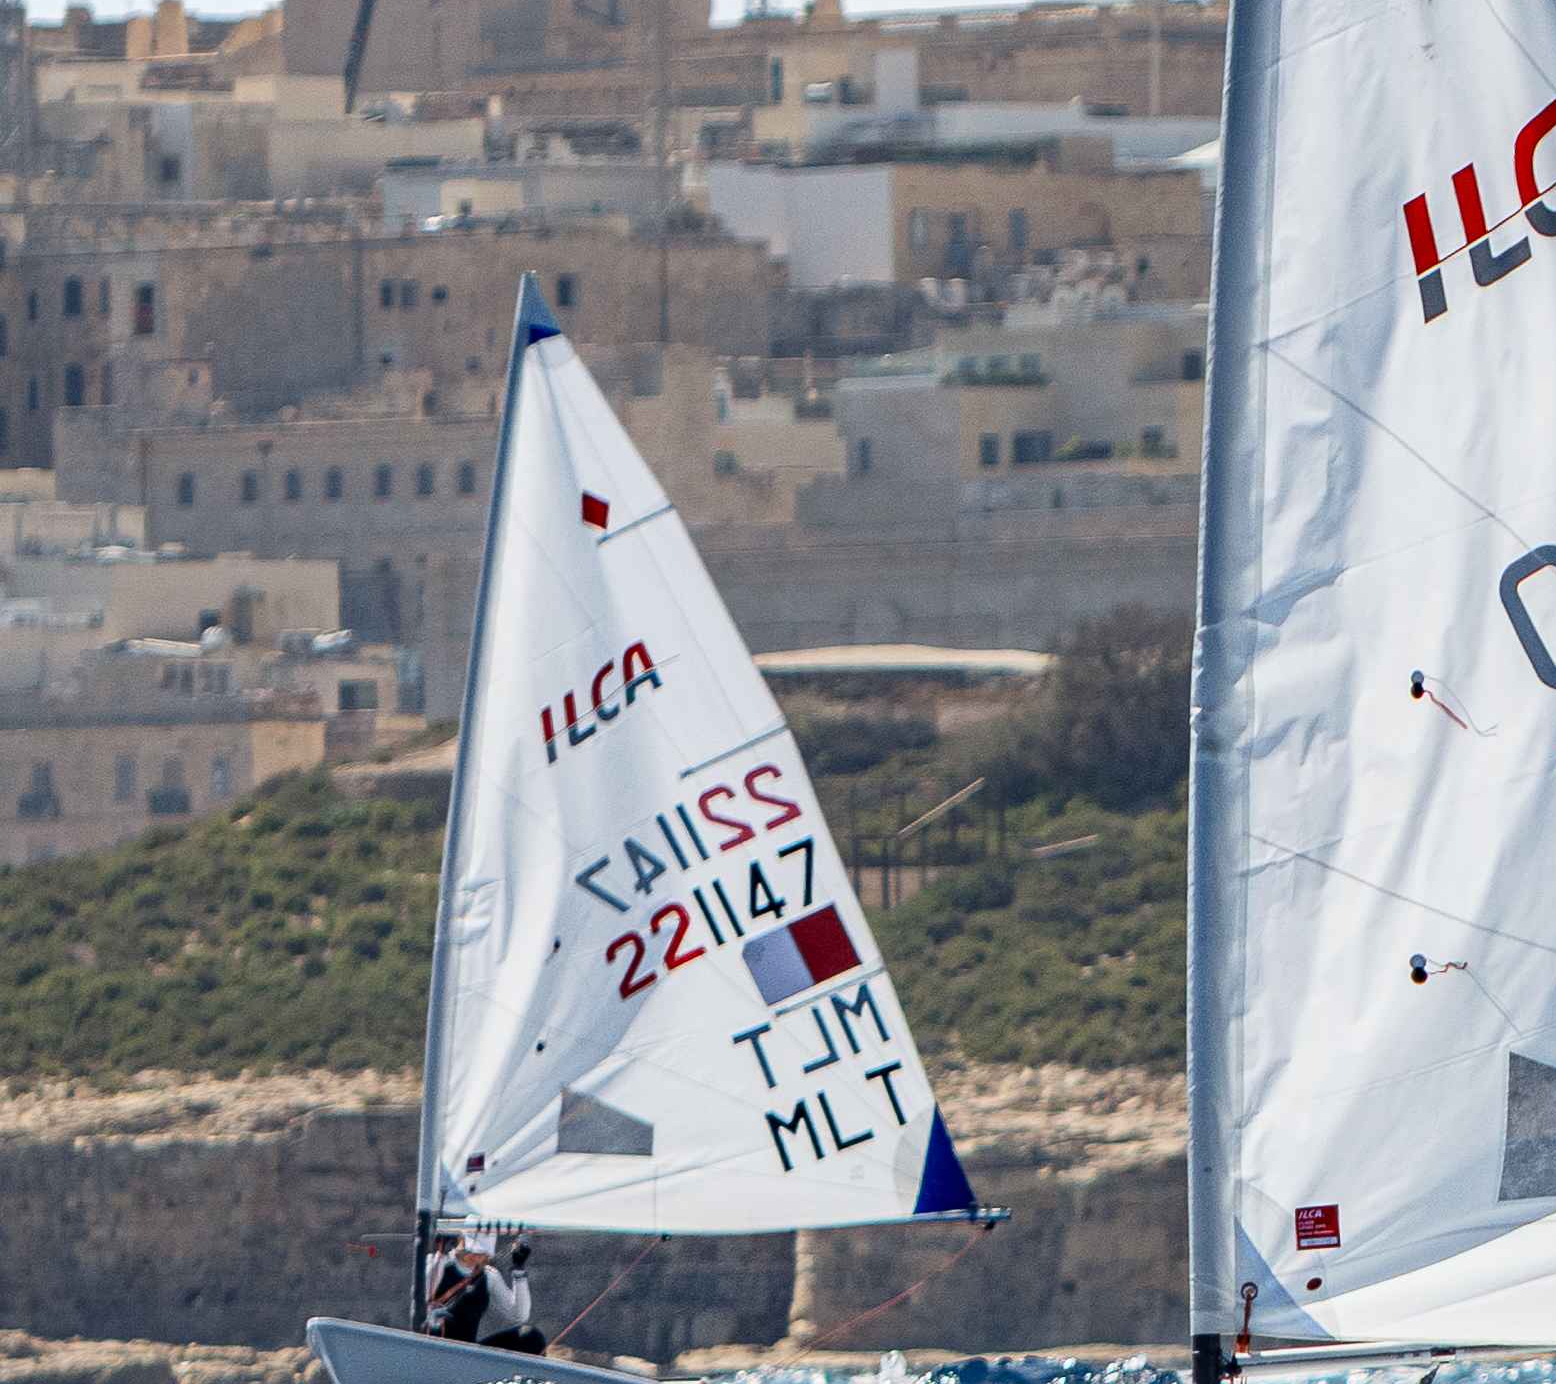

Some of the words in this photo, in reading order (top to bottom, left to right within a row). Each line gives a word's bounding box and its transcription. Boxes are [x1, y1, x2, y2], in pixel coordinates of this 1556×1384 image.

[540, 639, 663, 763] ILCA
[605, 838, 815, 1002] 221147
[765, 1061, 907, 1172] MLT
